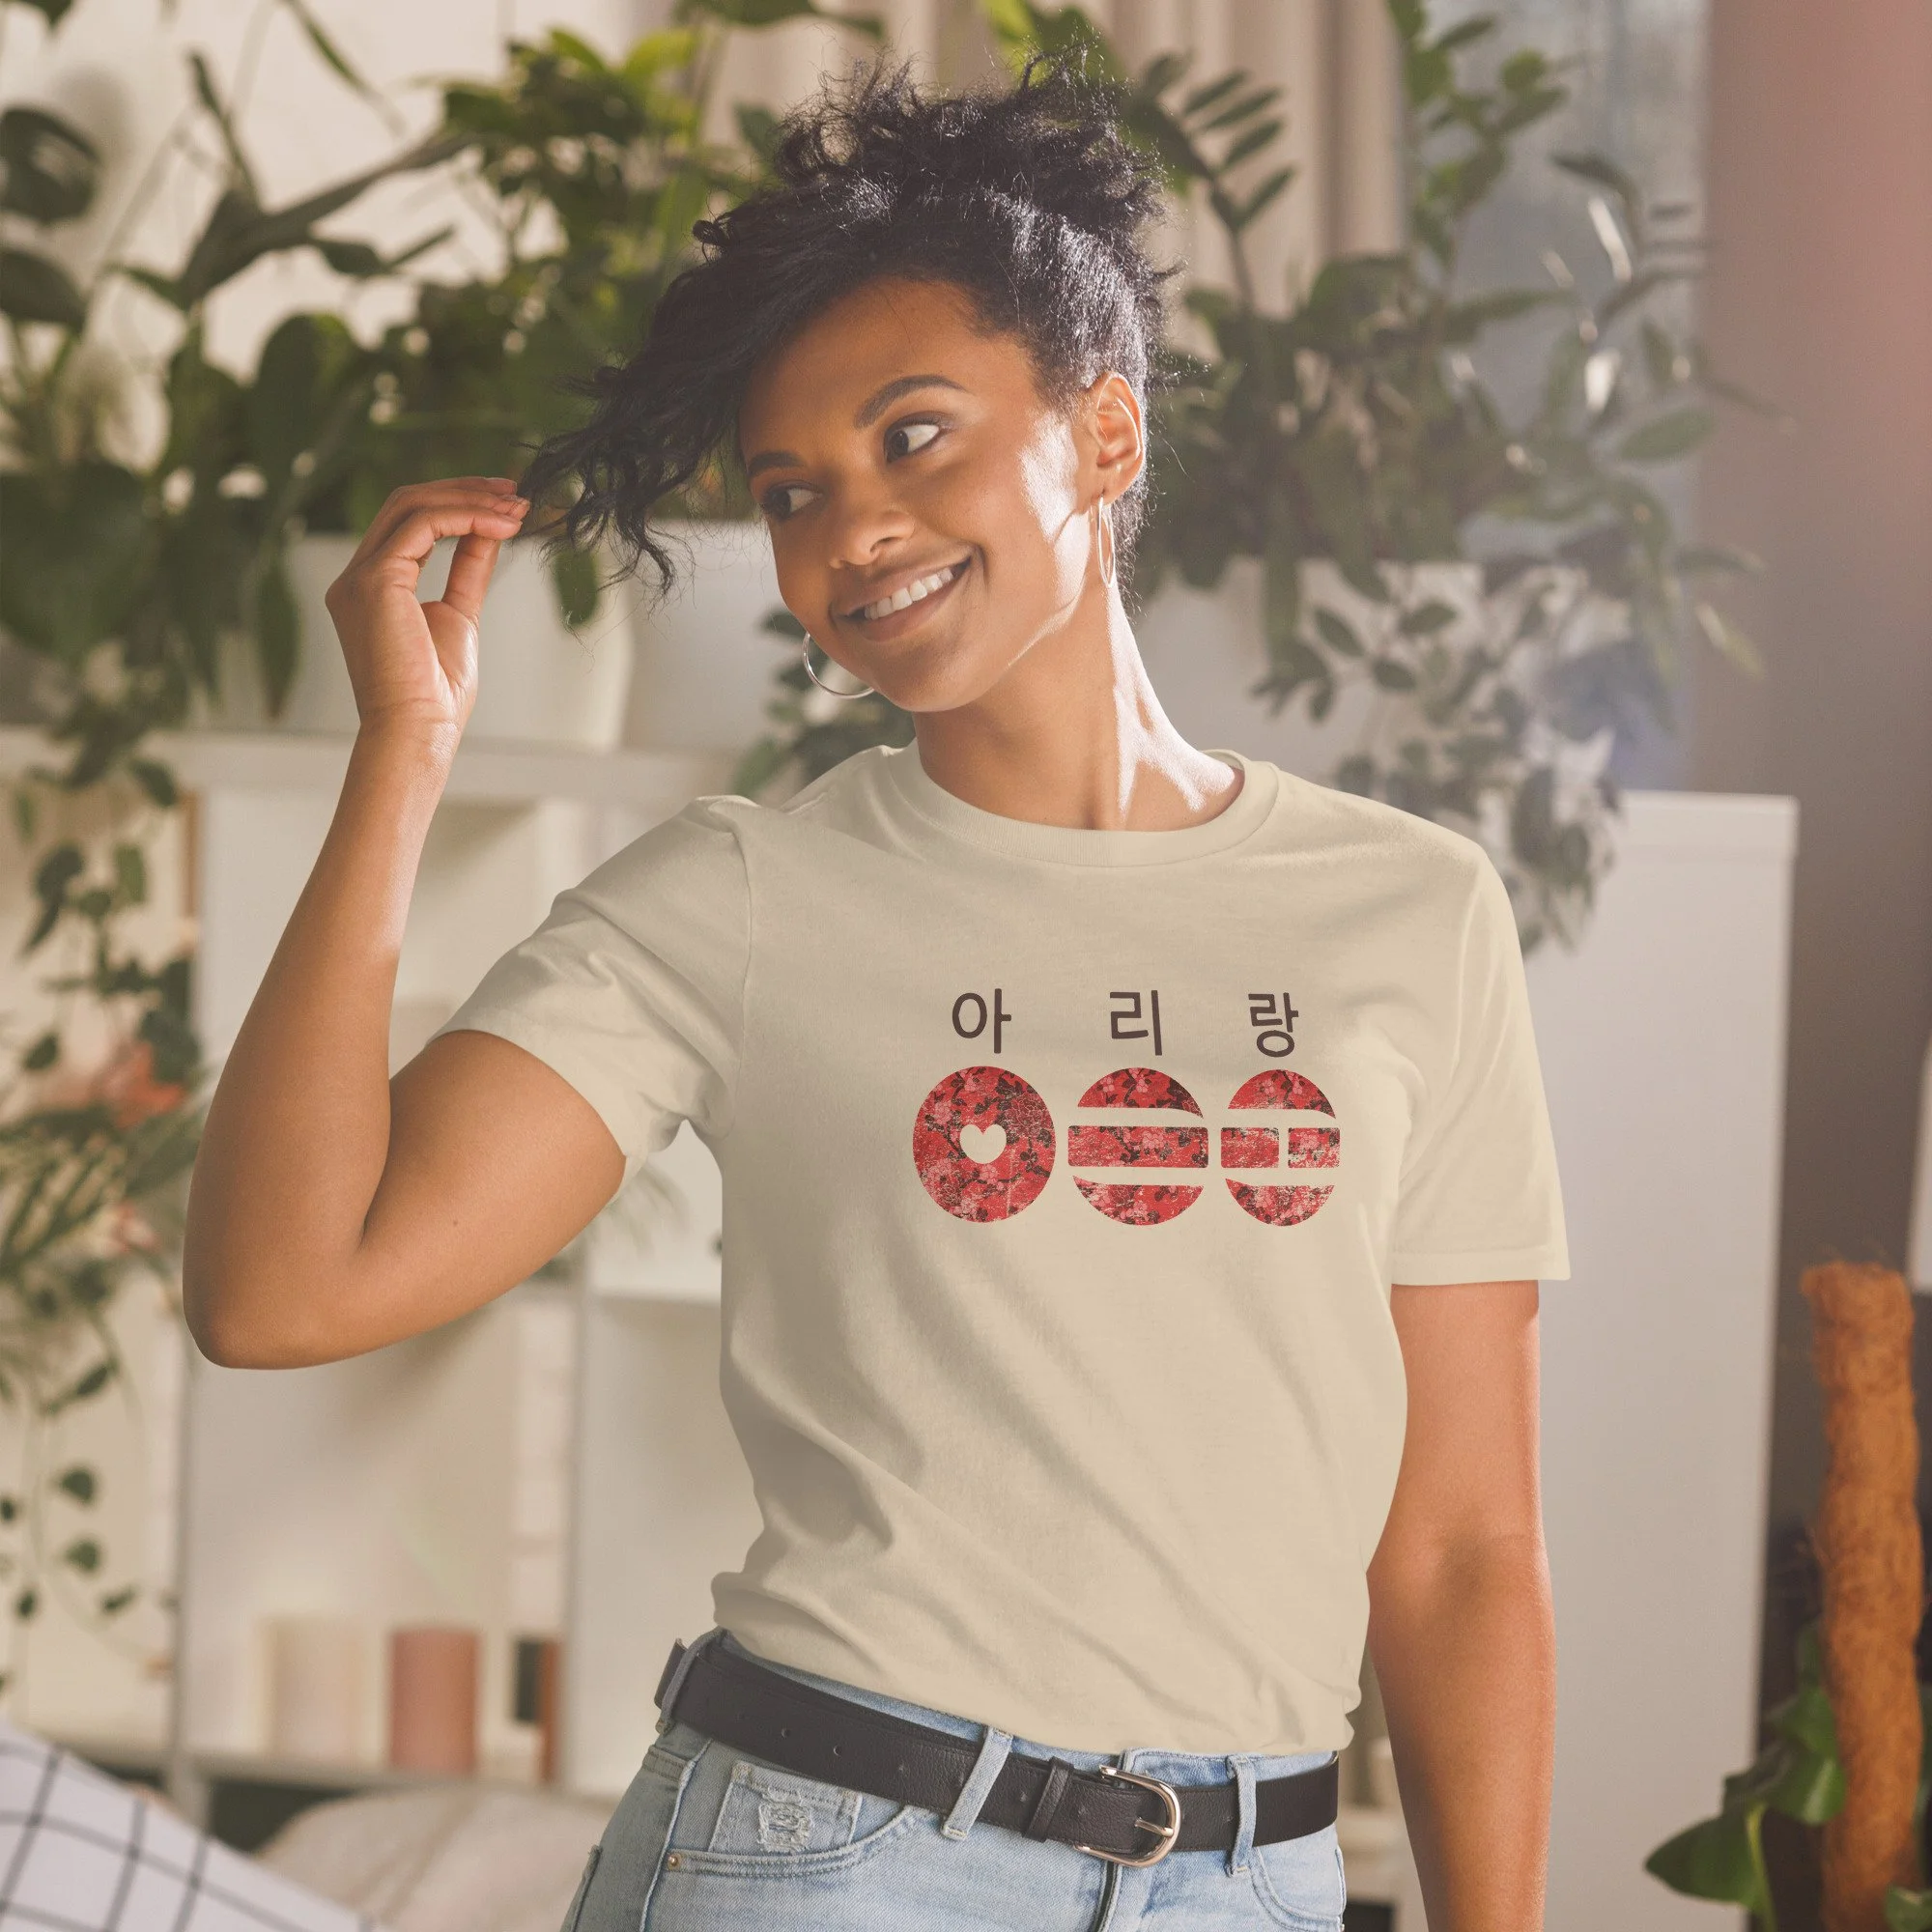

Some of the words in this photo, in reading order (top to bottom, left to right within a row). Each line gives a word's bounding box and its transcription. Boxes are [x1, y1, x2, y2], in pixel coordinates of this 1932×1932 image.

[952, 987, 1012, 1055] 아
[1109, 989, 1163, 1057] 리
[1247, 991, 1299, 1058] 랑
